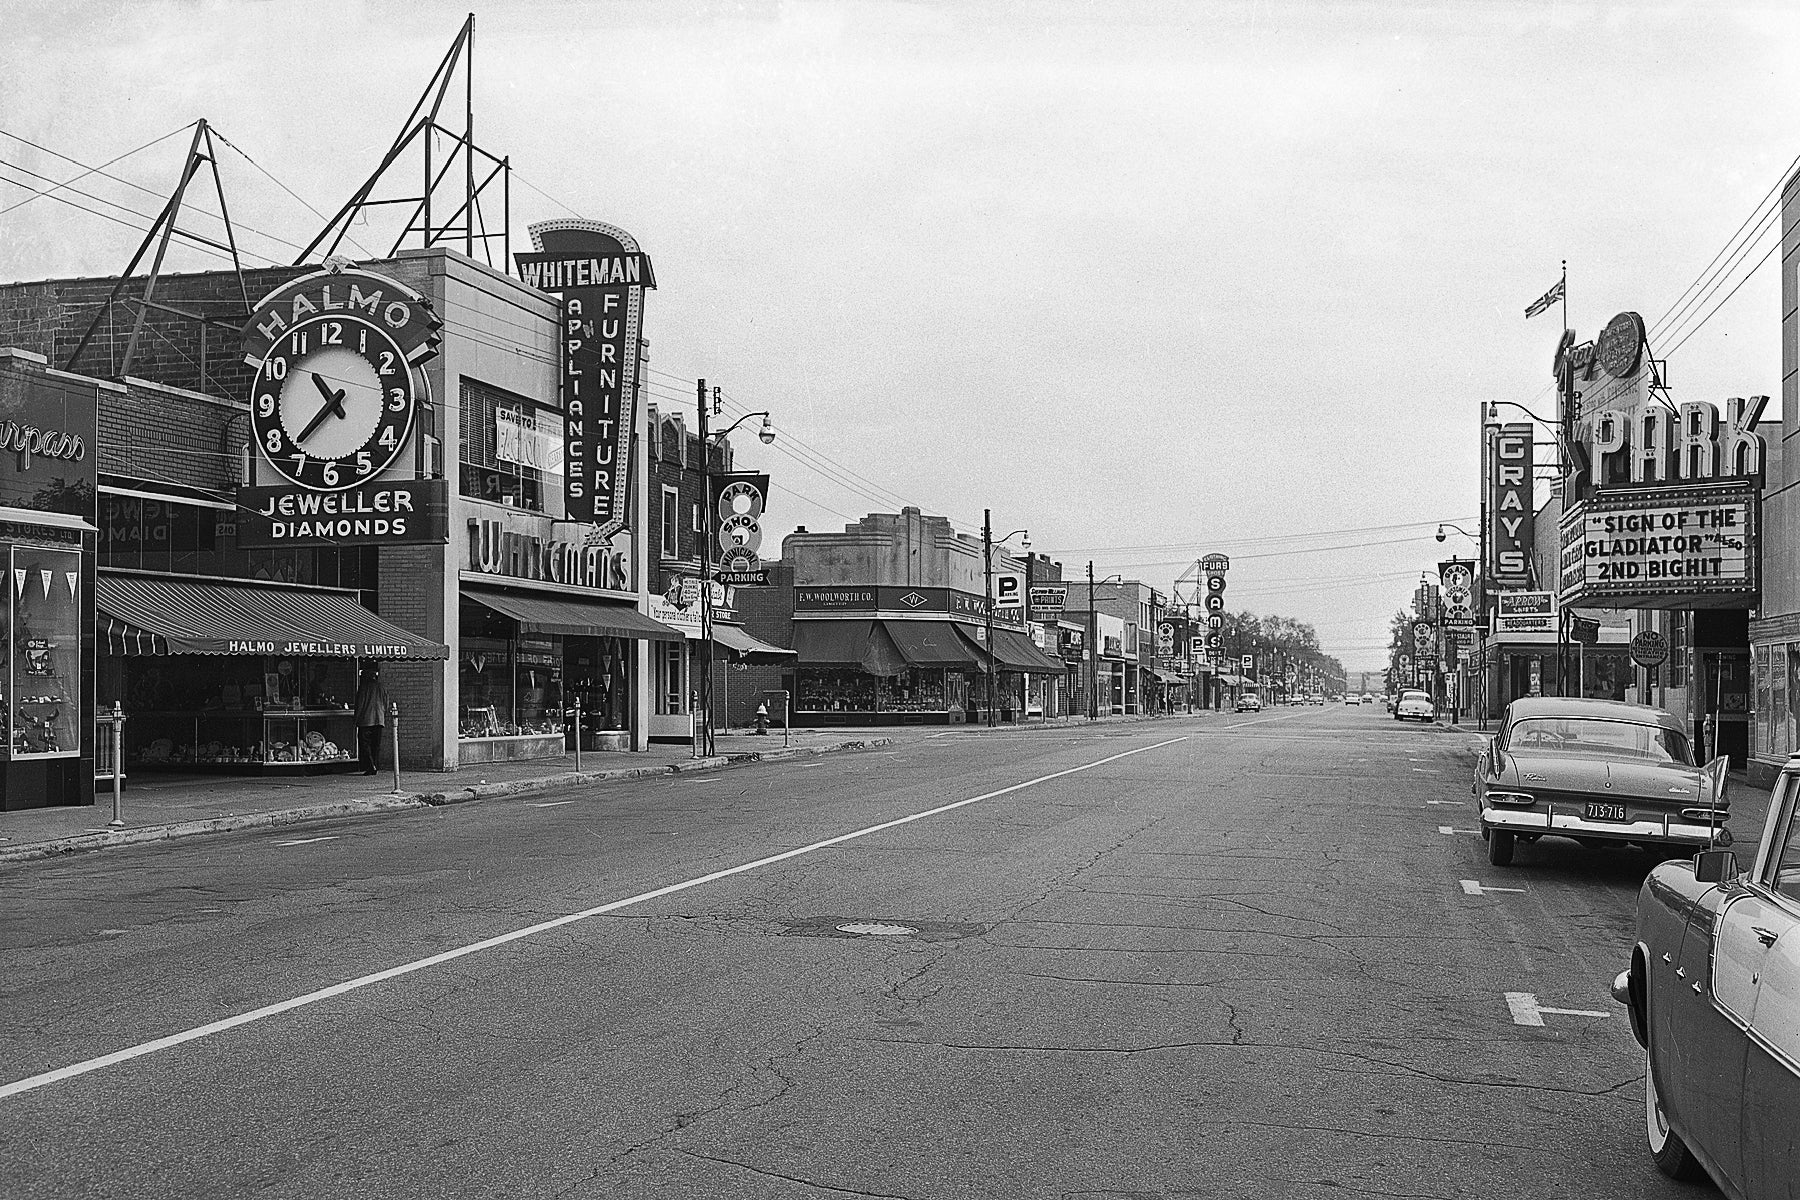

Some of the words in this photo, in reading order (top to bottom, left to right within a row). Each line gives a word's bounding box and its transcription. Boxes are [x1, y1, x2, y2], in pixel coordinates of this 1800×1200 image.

[521, 255, 640, 288] WHITEMAN
[256, 284, 412, 340] HALMO
[292, 332, 308, 355] 11
[321, 322, 343, 346] 12
[360, 329, 368, 353] 1
[265, 357, 288, 381] 10
[378, 352, 396, 375] 2
[259, 394, 275, 418] 9
[389, 388, 406, 411] 3
[567, 299, 585, 497] APPLIANCES
[594, 293, 621, 514] FURNITURE
[266, 429, 282, 453] 8
[378, 426, 397, 451] 4
[1592, 396, 1770, 485] PARK
[290, 453, 306, 477] 7
[324, 461, 339, 485] 6
[355, 451, 372, 475] 5
[259, 490, 414, 517] JEWELLER
[722, 484, 760, 502] PARK
[272, 517, 407, 539] DIAMONDS
[723, 516, 758, 533] SHOP
[1662, 511, 1689, 530] OF
[1696, 508, 1736, 528] THE
[723, 547, 758, 566] MUNICIPAL
[1204, 562, 1228, 570] FURS
[720, 573, 764, 583] PARKING
[1598, 561, 1640, 580] 2ND
[815, 592, 860, 602] WOOLWORTH
[1506, 596, 1542, 606] ARROW
[716, 611, 731, 620] STORE
[1507, 619, 1545, 627] HEADQUARTERS
[1635, 638, 1664, 648] PARKING
[1643, 631, 1659, 640] NO
[229, 640, 275, 654] HALMO
[284, 641, 357, 656] JEWELLERS
[364, 644, 408, 657] LIMITED
